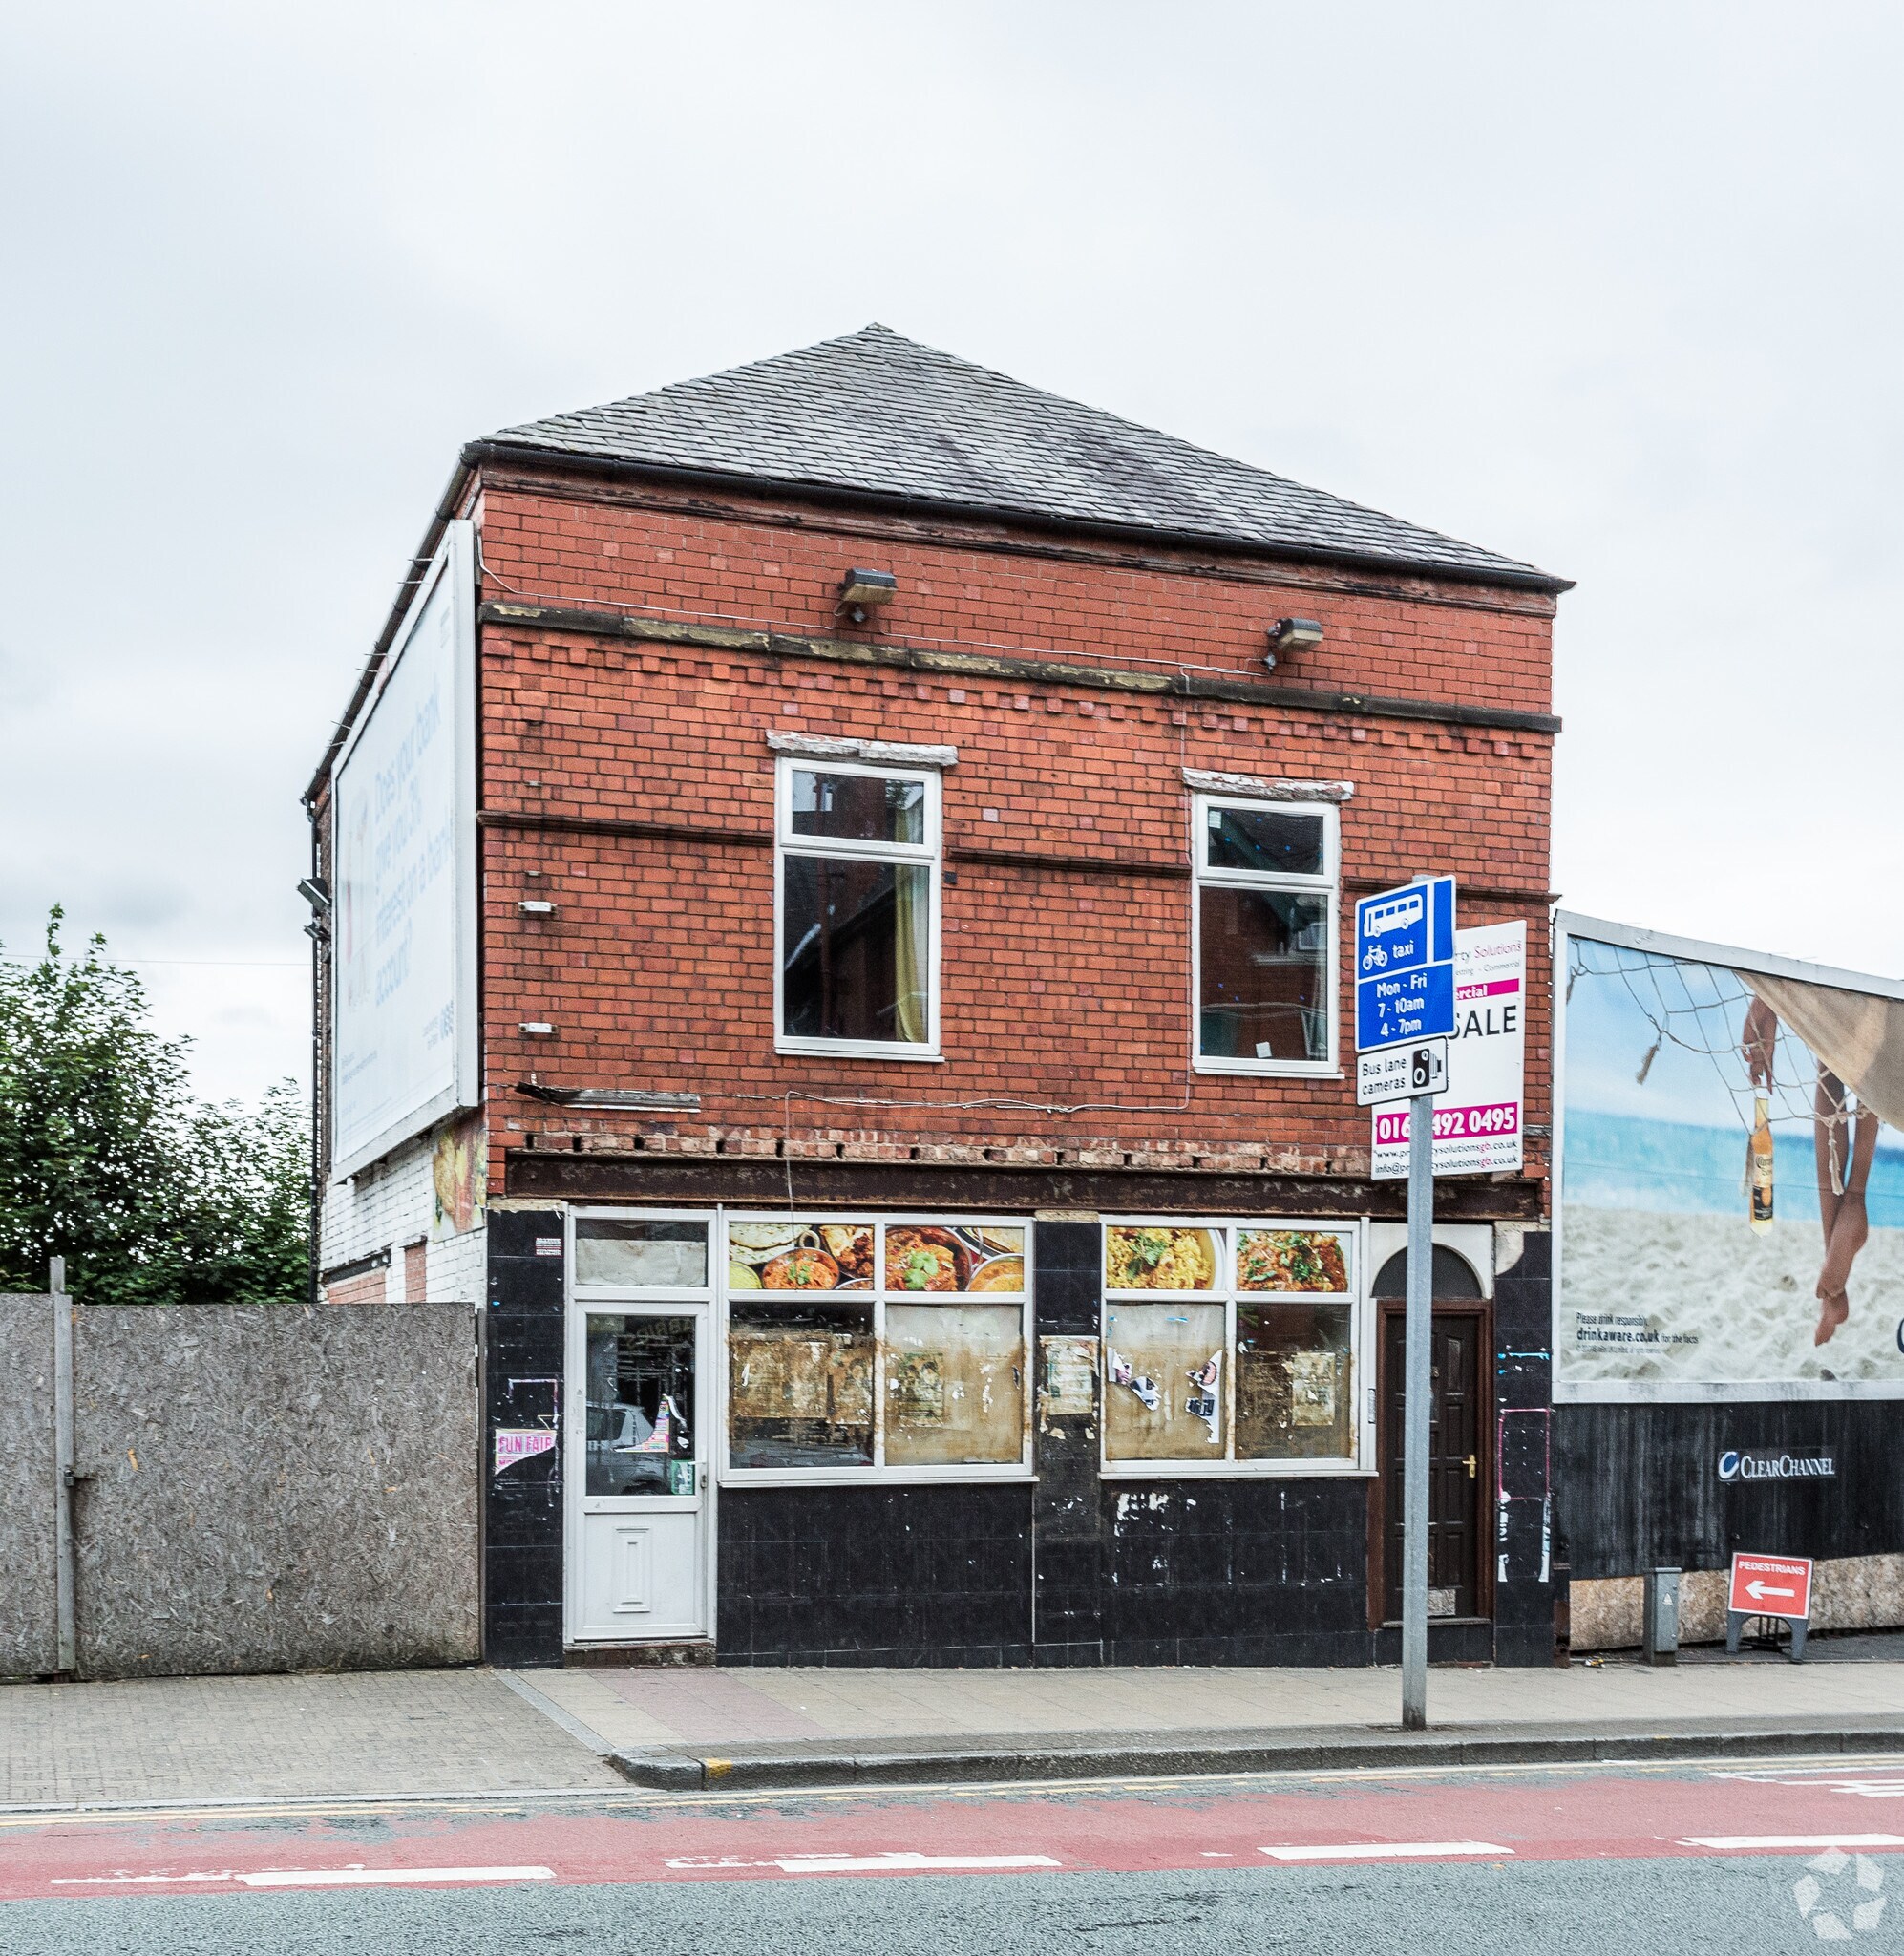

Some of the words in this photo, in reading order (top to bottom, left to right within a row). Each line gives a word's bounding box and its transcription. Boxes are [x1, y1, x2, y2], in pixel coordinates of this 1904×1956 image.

[374, 761, 394, 823] Does
[395, 726, 414, 802] your
[416, 672, 441, 756] bank
[1392, 939, 1414, 959] taxi
[1474, 941, 1522, 959] Solutions
[374, 917, 413, 1008] account?
[1483, 959, 1521, 973] Commercial
[1376, 982, 1401, 998] Mon
[1410, 972, 1428, 990] Fri
[1377, 1002, 1386, 1018] 7
[1394, 997, 1425, 1014] 10am
[1380, 1022, 1389, 1037] 4
[1398, 1018, 1422, 1036] 7pm
[1363, 1062, 1382, 1077] Bus
[1385, 1053, 1407, 1072] lane
[1362, 1076, 1406, 1095] cameras
[1378, 1116, 1411, 1140] 016
[1432, 1111, 1466, 1136] 492
[1469, 1106, 1516, 1134] 0495
[1576, 1311, 1597, 1324] Please
[1598, 1313, 1614, 1325] drink
[1576, 1327, 1661, 1344] drinkaware.co.uk
[1661, 1333, 1671, 1343] for
[1672, 1332, 1682, 1344] the
[1683, 1333, 1700, 1345] facts
[498, 1435, 522, 1453] FUN
[1738, 1560, 1807, 1577] PEDESTRIANS
